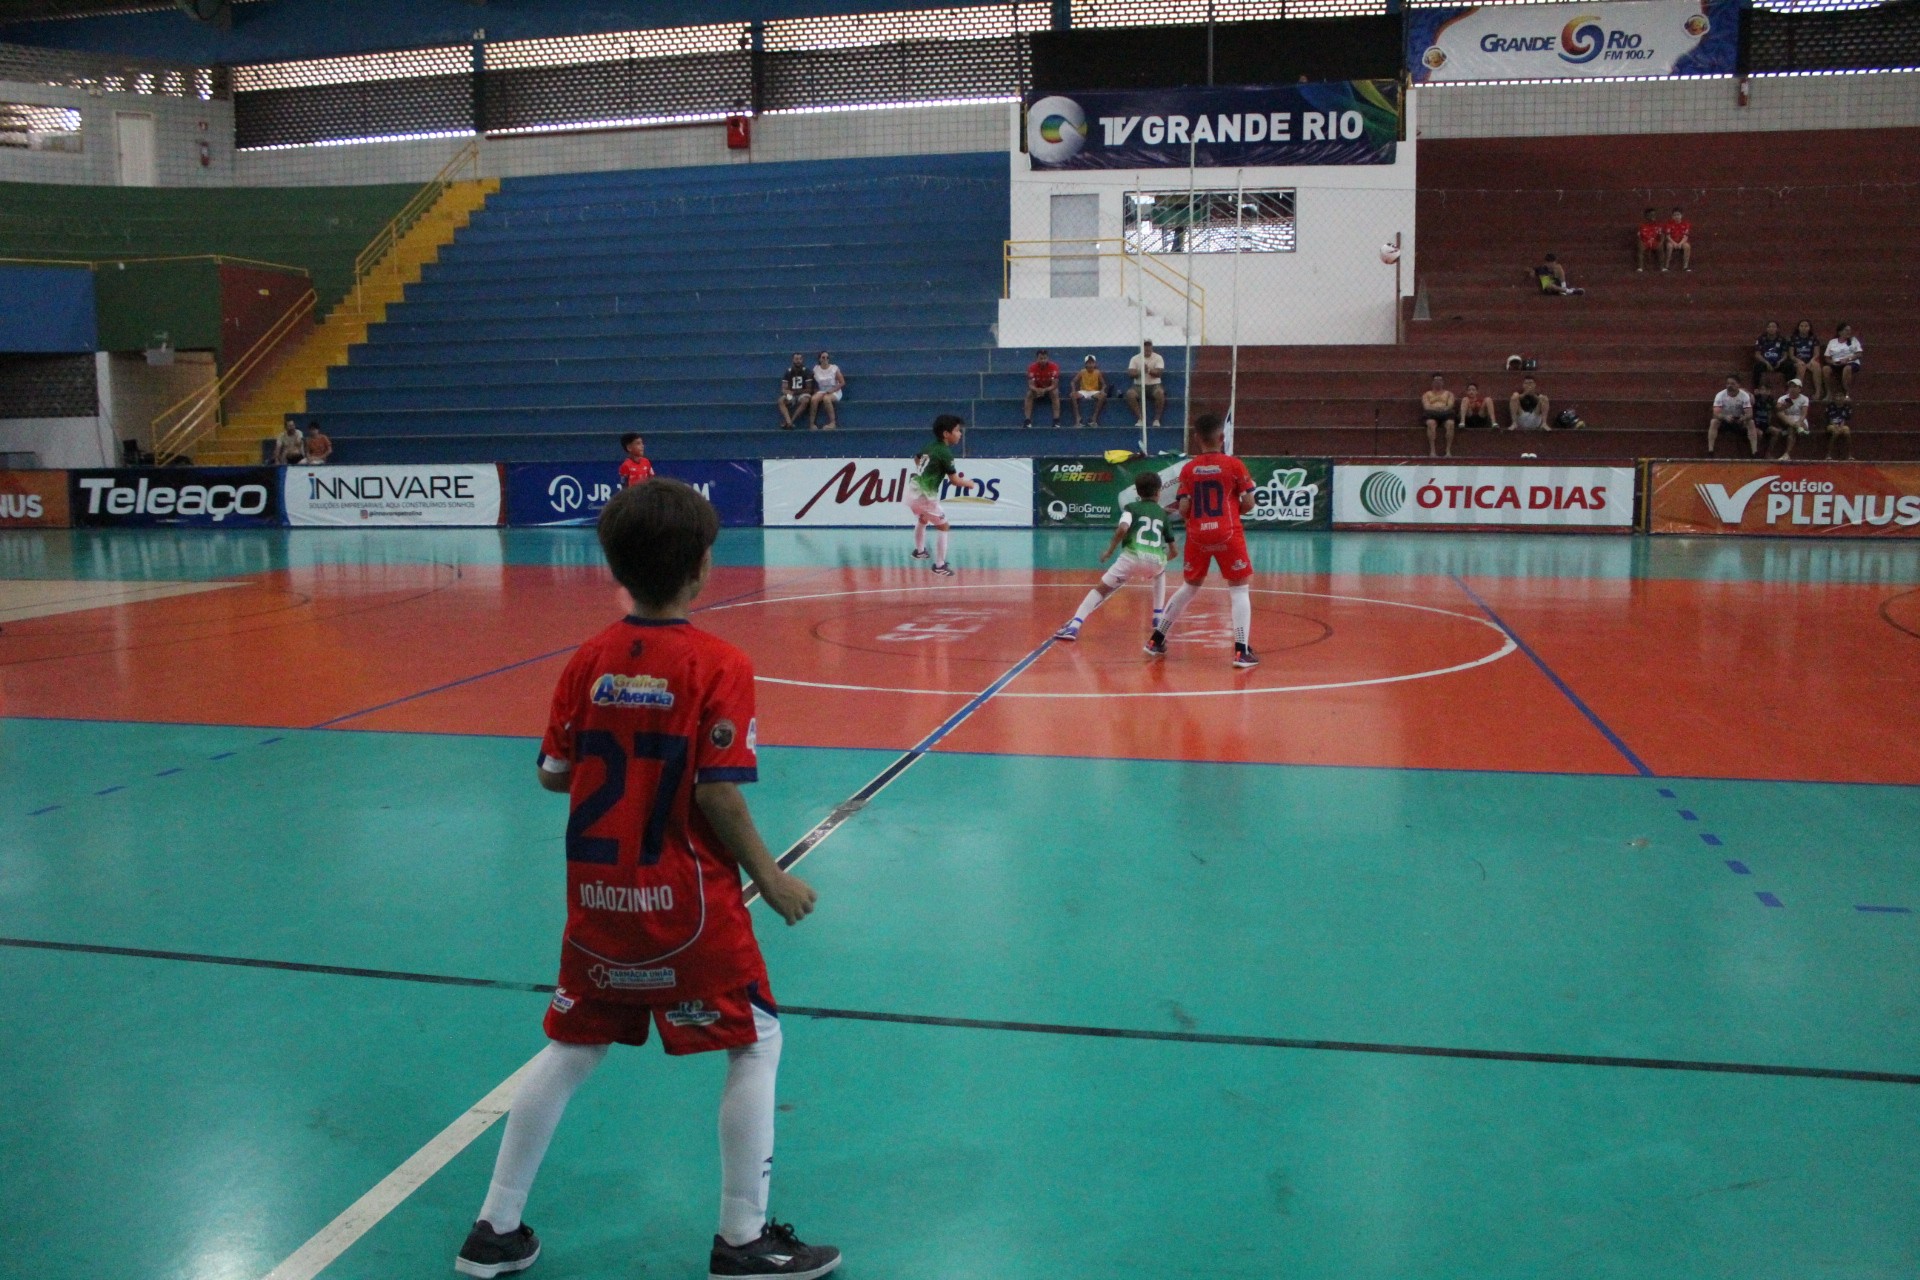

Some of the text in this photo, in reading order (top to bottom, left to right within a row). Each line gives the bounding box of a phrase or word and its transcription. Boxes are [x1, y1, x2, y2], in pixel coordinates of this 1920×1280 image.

[1480, 30, 1642, 52] GRANDE RIO
[1604, 49, 1654, 60] FM 100.7
[1099, 110, 1363, 145] TV GRANDE RIO
[791, 376, 803, 389] 12
[79, 478, 267, 521] Teleaço
[587, 483, 611, 501] JR
[1193, 480, 1223, 518] 10
[1416, 478, 1606, 510] ÓTICA DIAS
[1770, 479, 1834, 493] COLÉGIO
[0, 494, 43, 518] US
[1068, 503, 1111, 513] BioGrow
[1257, 508, 1310, 517] DO VALE
[1766, 494, 1920, 526] PLENUS
[1136, 515, 1164, 547] 25
[566, 729, 688, 866] 27
[580, 880, 674, 912] JOÃOZINHO
